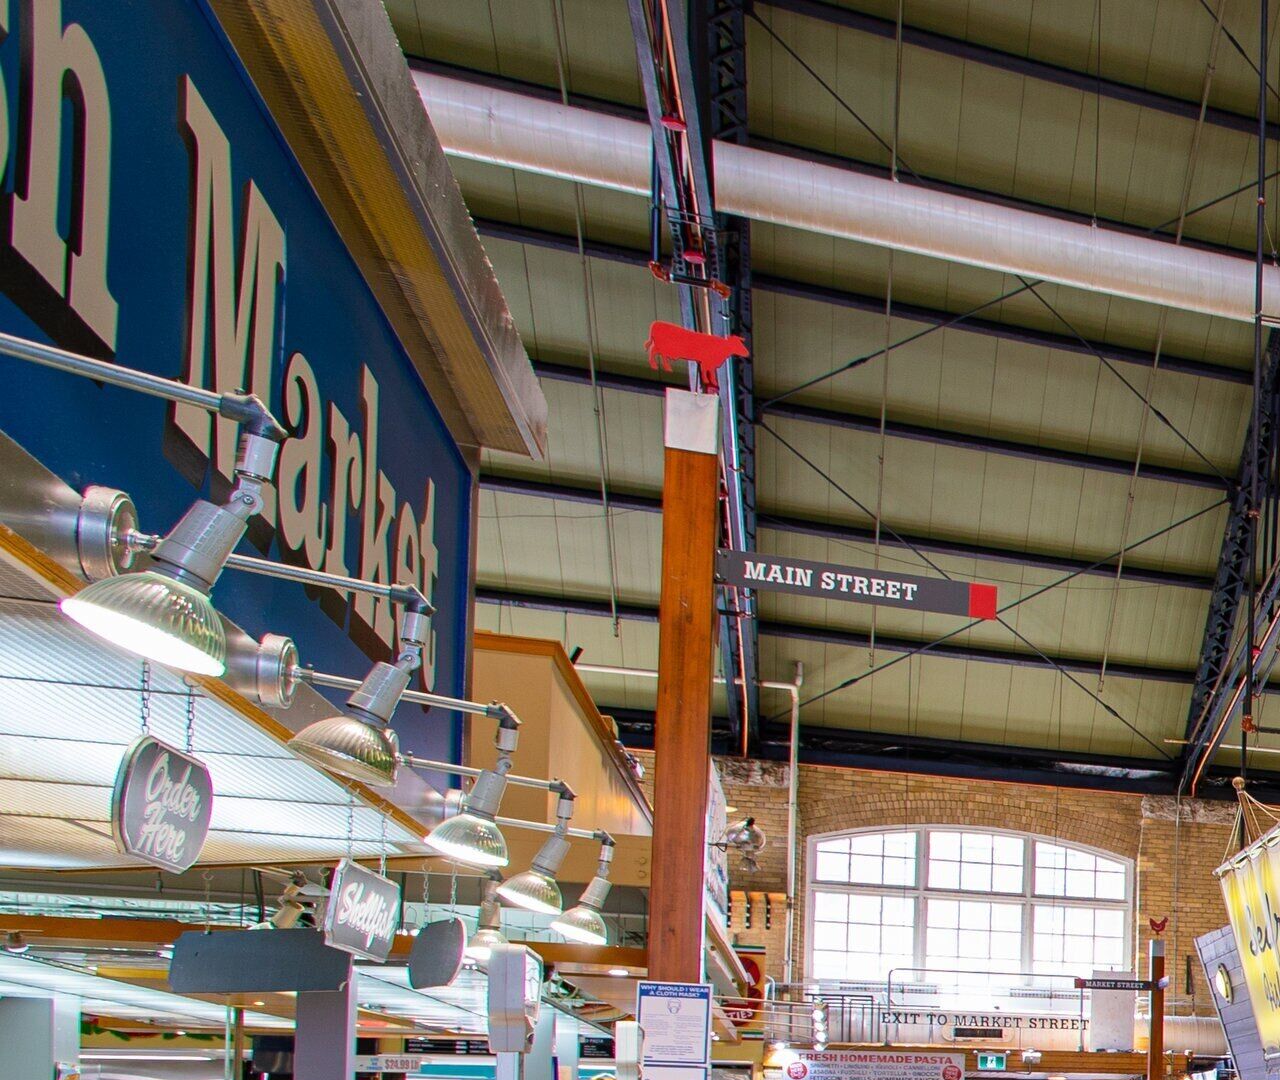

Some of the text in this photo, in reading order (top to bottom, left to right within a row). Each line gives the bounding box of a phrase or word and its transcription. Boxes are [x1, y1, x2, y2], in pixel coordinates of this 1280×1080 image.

[174, 73, 438, 692] Market
[744, 561, 917, 600] MAIN STREET
[145, 752, 201, 822] Order
[140, 803, 185, 859] Here
[337, 882, 395, 948] Shellfish
[1085, 980, 1115, 988] MARKET
[882, 1012, 1089, 1030] EXIT TO MARKET STREET
[799, 1053, 953, 1064] FRESH HOMEMADE PASTA
